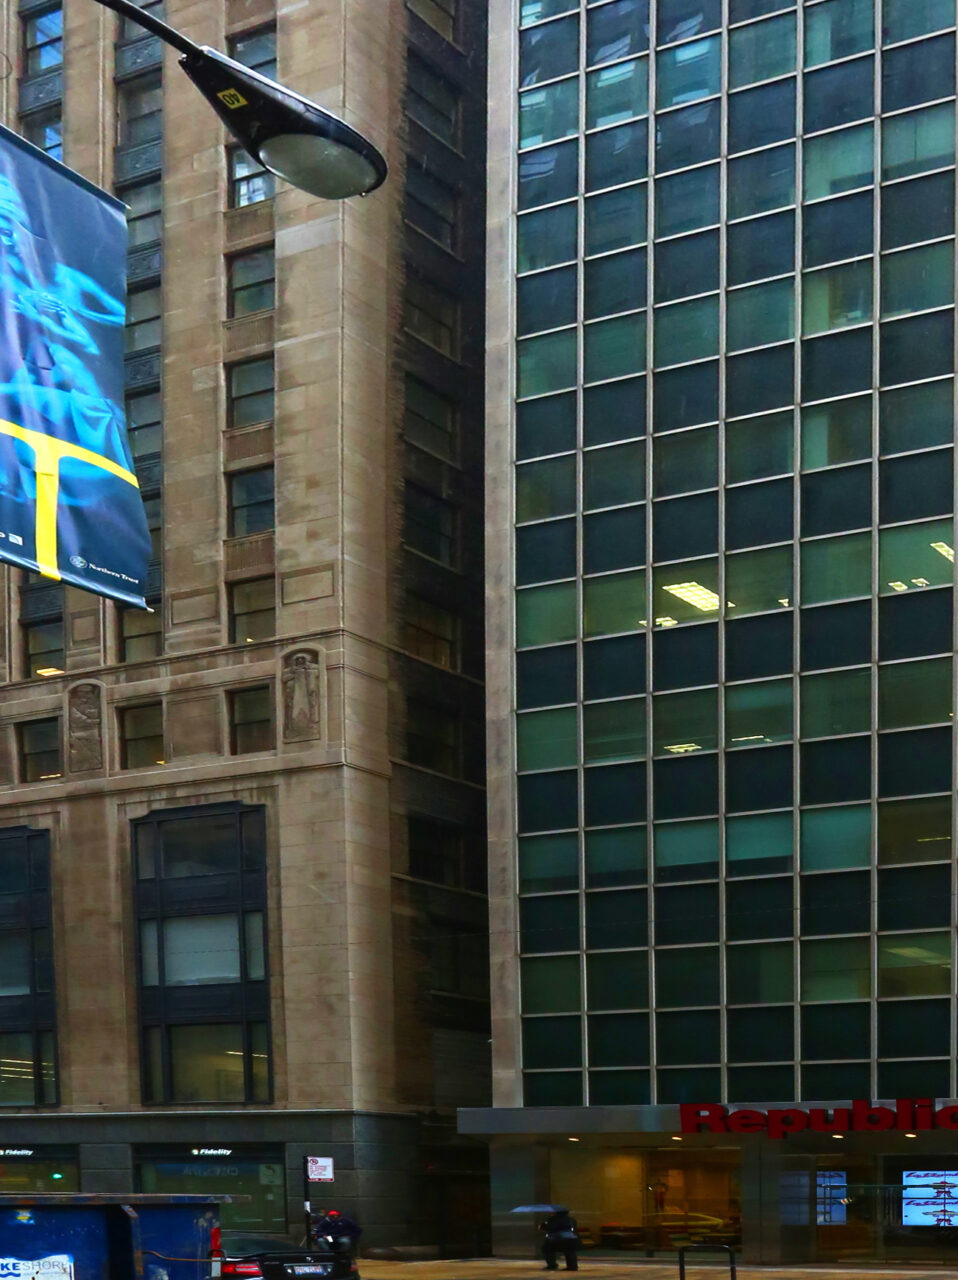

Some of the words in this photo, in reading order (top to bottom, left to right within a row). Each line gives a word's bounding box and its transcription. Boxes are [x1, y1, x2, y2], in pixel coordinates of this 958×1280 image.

[88, 563, 121, 578] Northern
[120, 573, 139, 584] Trust
[5, 1148, 33, 1156] Fidelity
[200, 1148, 232, 1156] Fidelity
